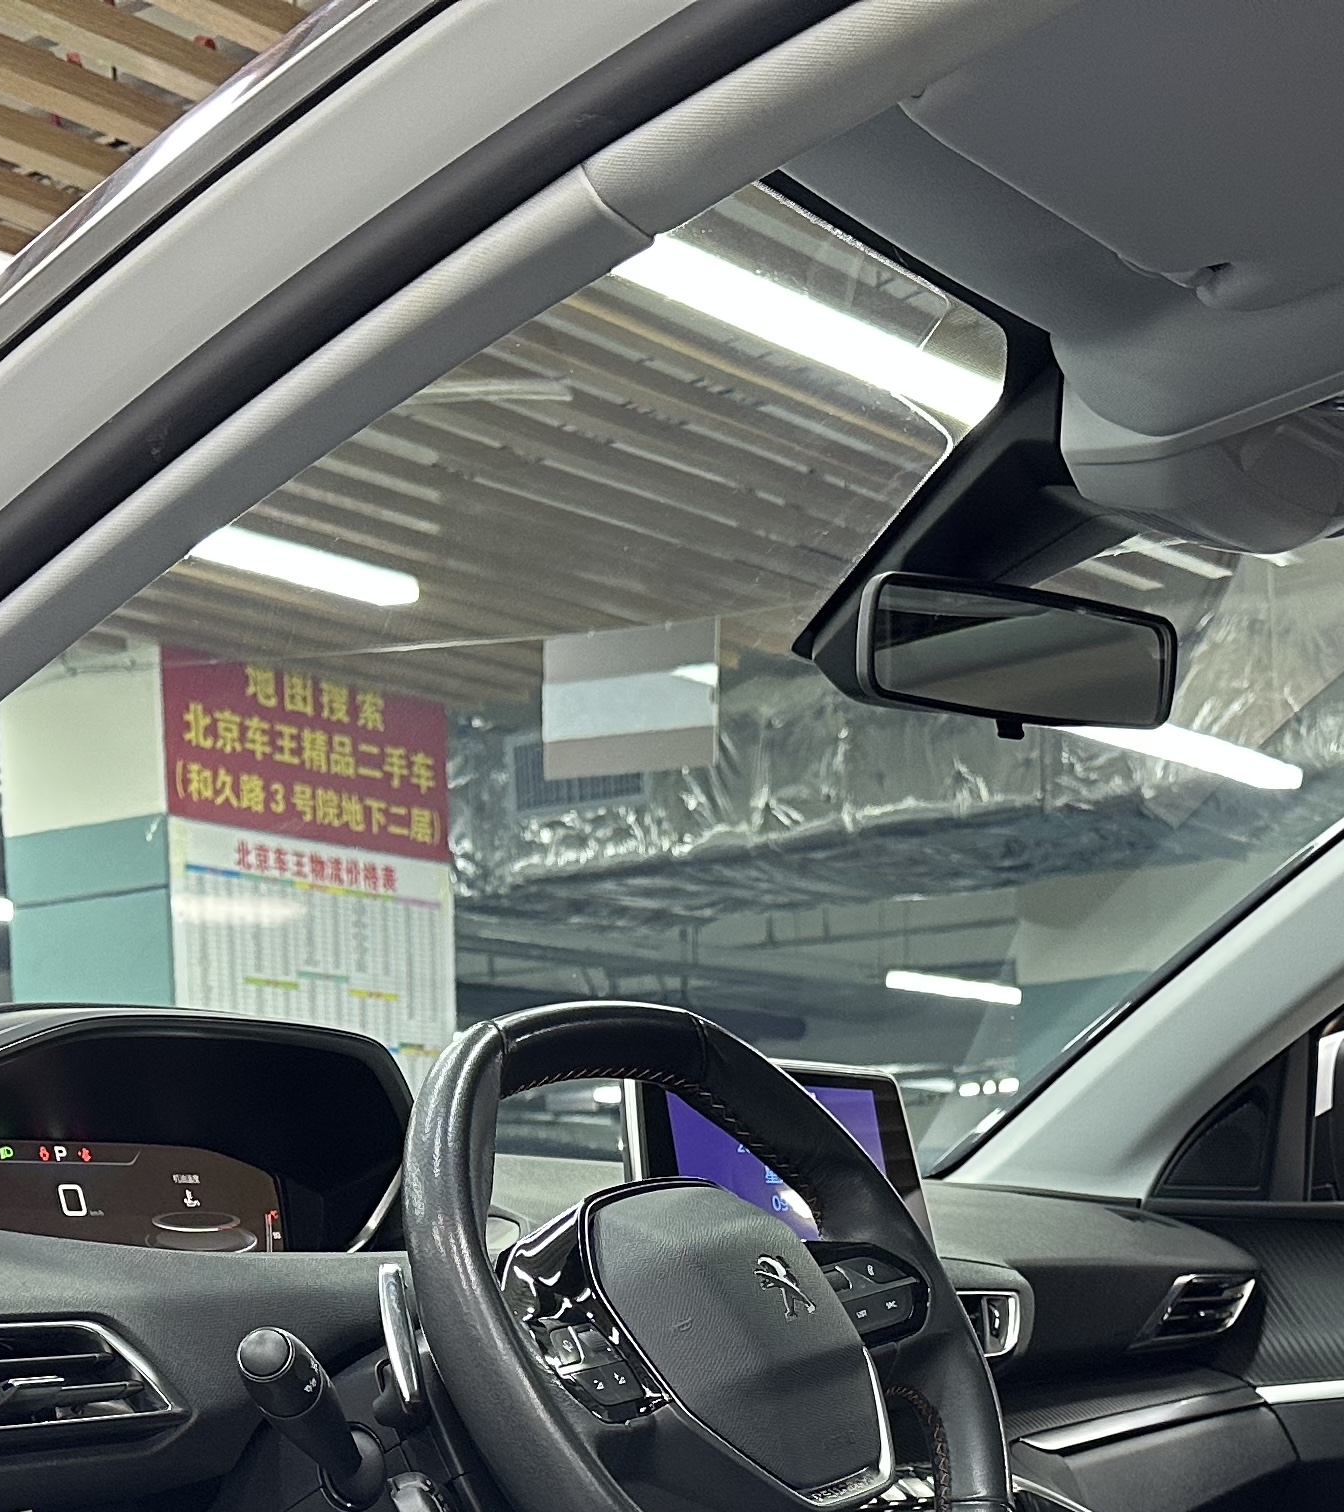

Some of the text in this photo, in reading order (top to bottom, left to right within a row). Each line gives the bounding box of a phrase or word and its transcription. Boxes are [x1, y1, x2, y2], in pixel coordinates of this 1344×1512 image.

[244, 664, 385, 733] 地图搜索
[183, 702, 437, 795] 北京车王精品二手车
[235, 839, 397, 891] 北京车王物流价格表
[53, 1145, 68, 1162] P
[57, 1183, 88, 1217] 0
